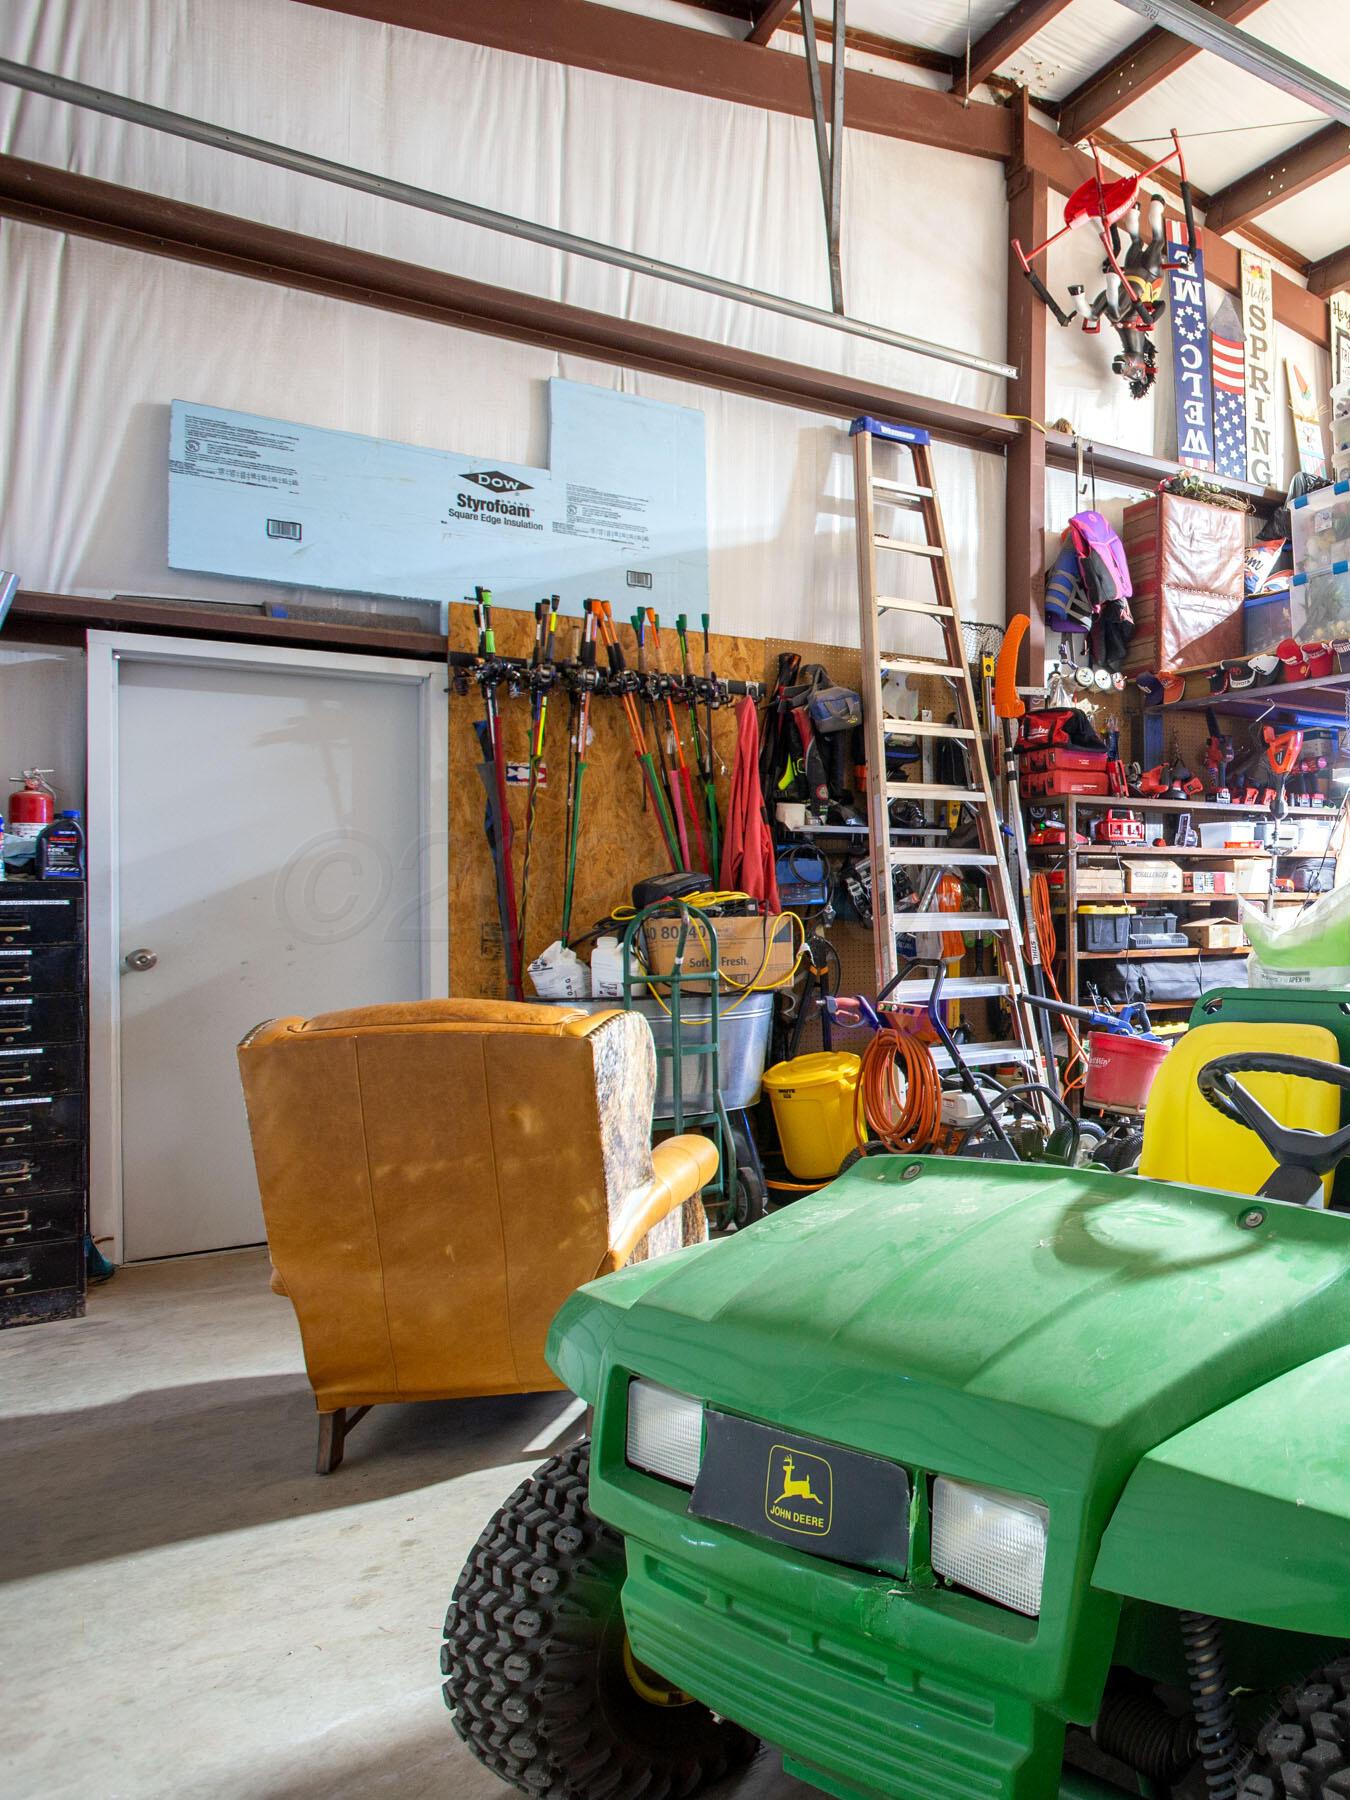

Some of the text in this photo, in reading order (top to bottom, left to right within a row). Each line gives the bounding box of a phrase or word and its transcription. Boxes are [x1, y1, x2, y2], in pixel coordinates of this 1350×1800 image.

[1244, 278, 1270, 303] Hello
[1248, 304, 1272, 486] SPRING
[478, 474, 520, 490] DOW
[457, 493, 530, 518] Styrofoam
[448, 508, 543, 531] Square Edge Insulation
[661, 926, 707, 940] 8040
[1030, 940, 1039, 960] STIHL
[690, 957, 709, 968] Soft
[770, 1504, 825, 1529] JOHN DEERE
